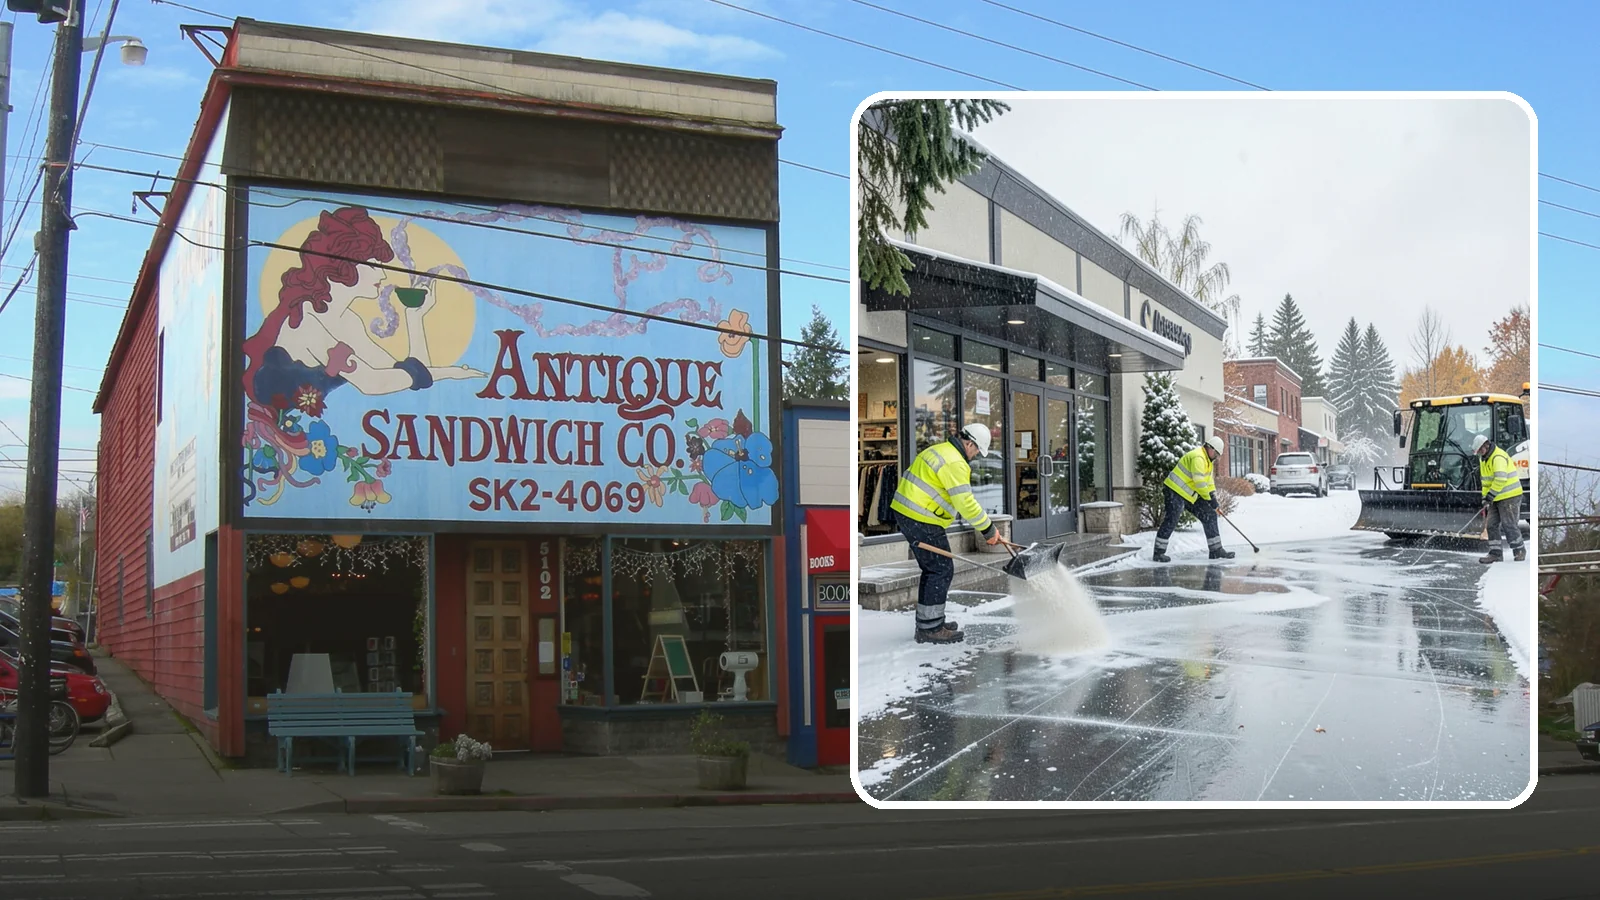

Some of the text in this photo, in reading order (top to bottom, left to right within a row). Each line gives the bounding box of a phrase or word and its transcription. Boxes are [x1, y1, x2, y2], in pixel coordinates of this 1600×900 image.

[475, 329, 724, 421] ANTIQUE
[361, 408, 685, 468] SANDWICH CO.
[468, 477, 645, 512] SK2-4069
[540, 541, 551, 600] 5102
[809, 555, 835, 569] BOOKS
